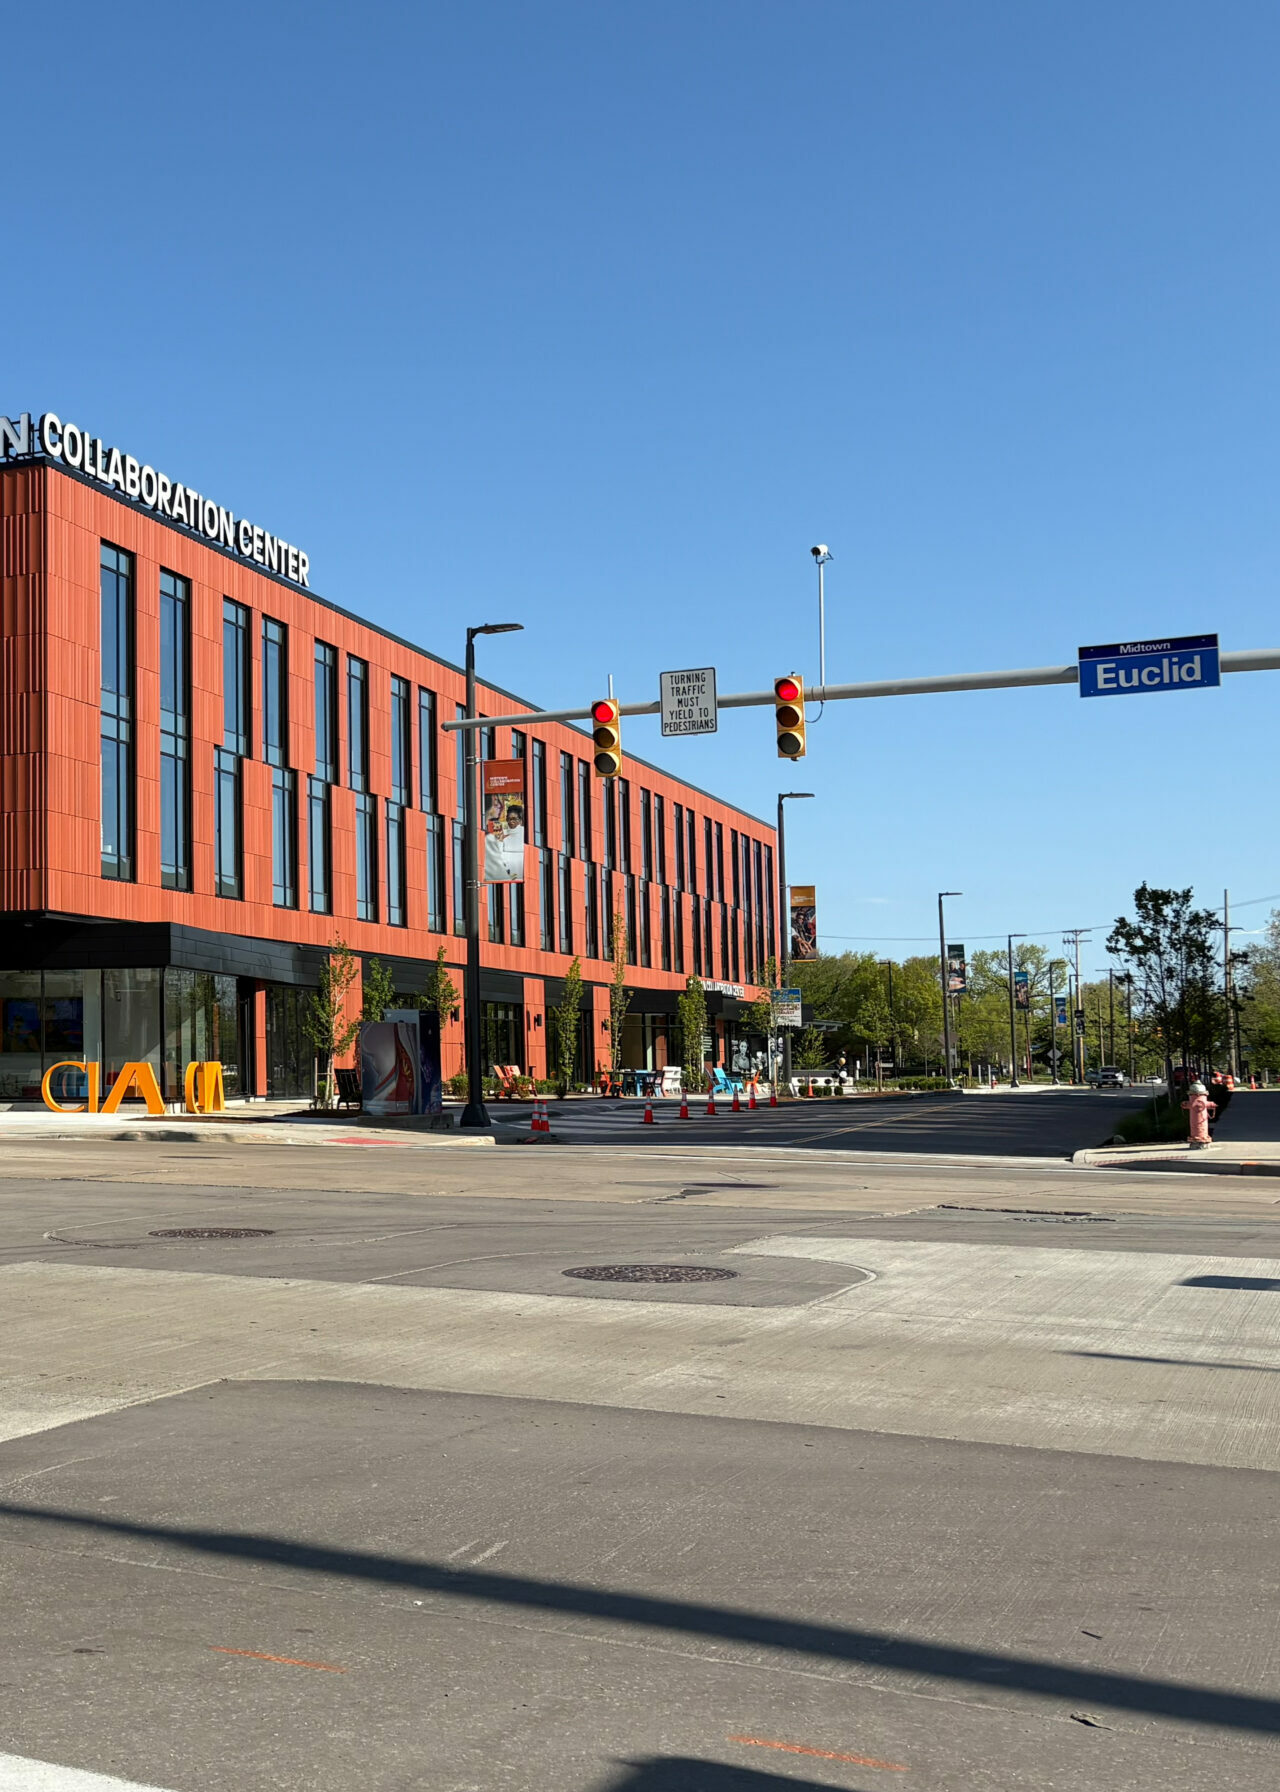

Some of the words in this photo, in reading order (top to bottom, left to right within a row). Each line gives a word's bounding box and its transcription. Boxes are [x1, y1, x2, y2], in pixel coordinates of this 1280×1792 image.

[40, 412, 234, 547] COLLABORATION
[237, 518, 310, 587] CENTER
[1119, 642, 1171, 654] Midtown
[670, 672, 706, 685] TURNING
[1096, 655, 1202, 689] Euclid
[670, 684, 706, 696] TRAFFIC
[677, 697, 699, 708] MUST
[669, 709, 693, 720] YIELD
[699, 707, 709, 718] TO
[664, 719, 714, 733] PEDESTRIANS
[41, 1060, 166, 1114] CIA
